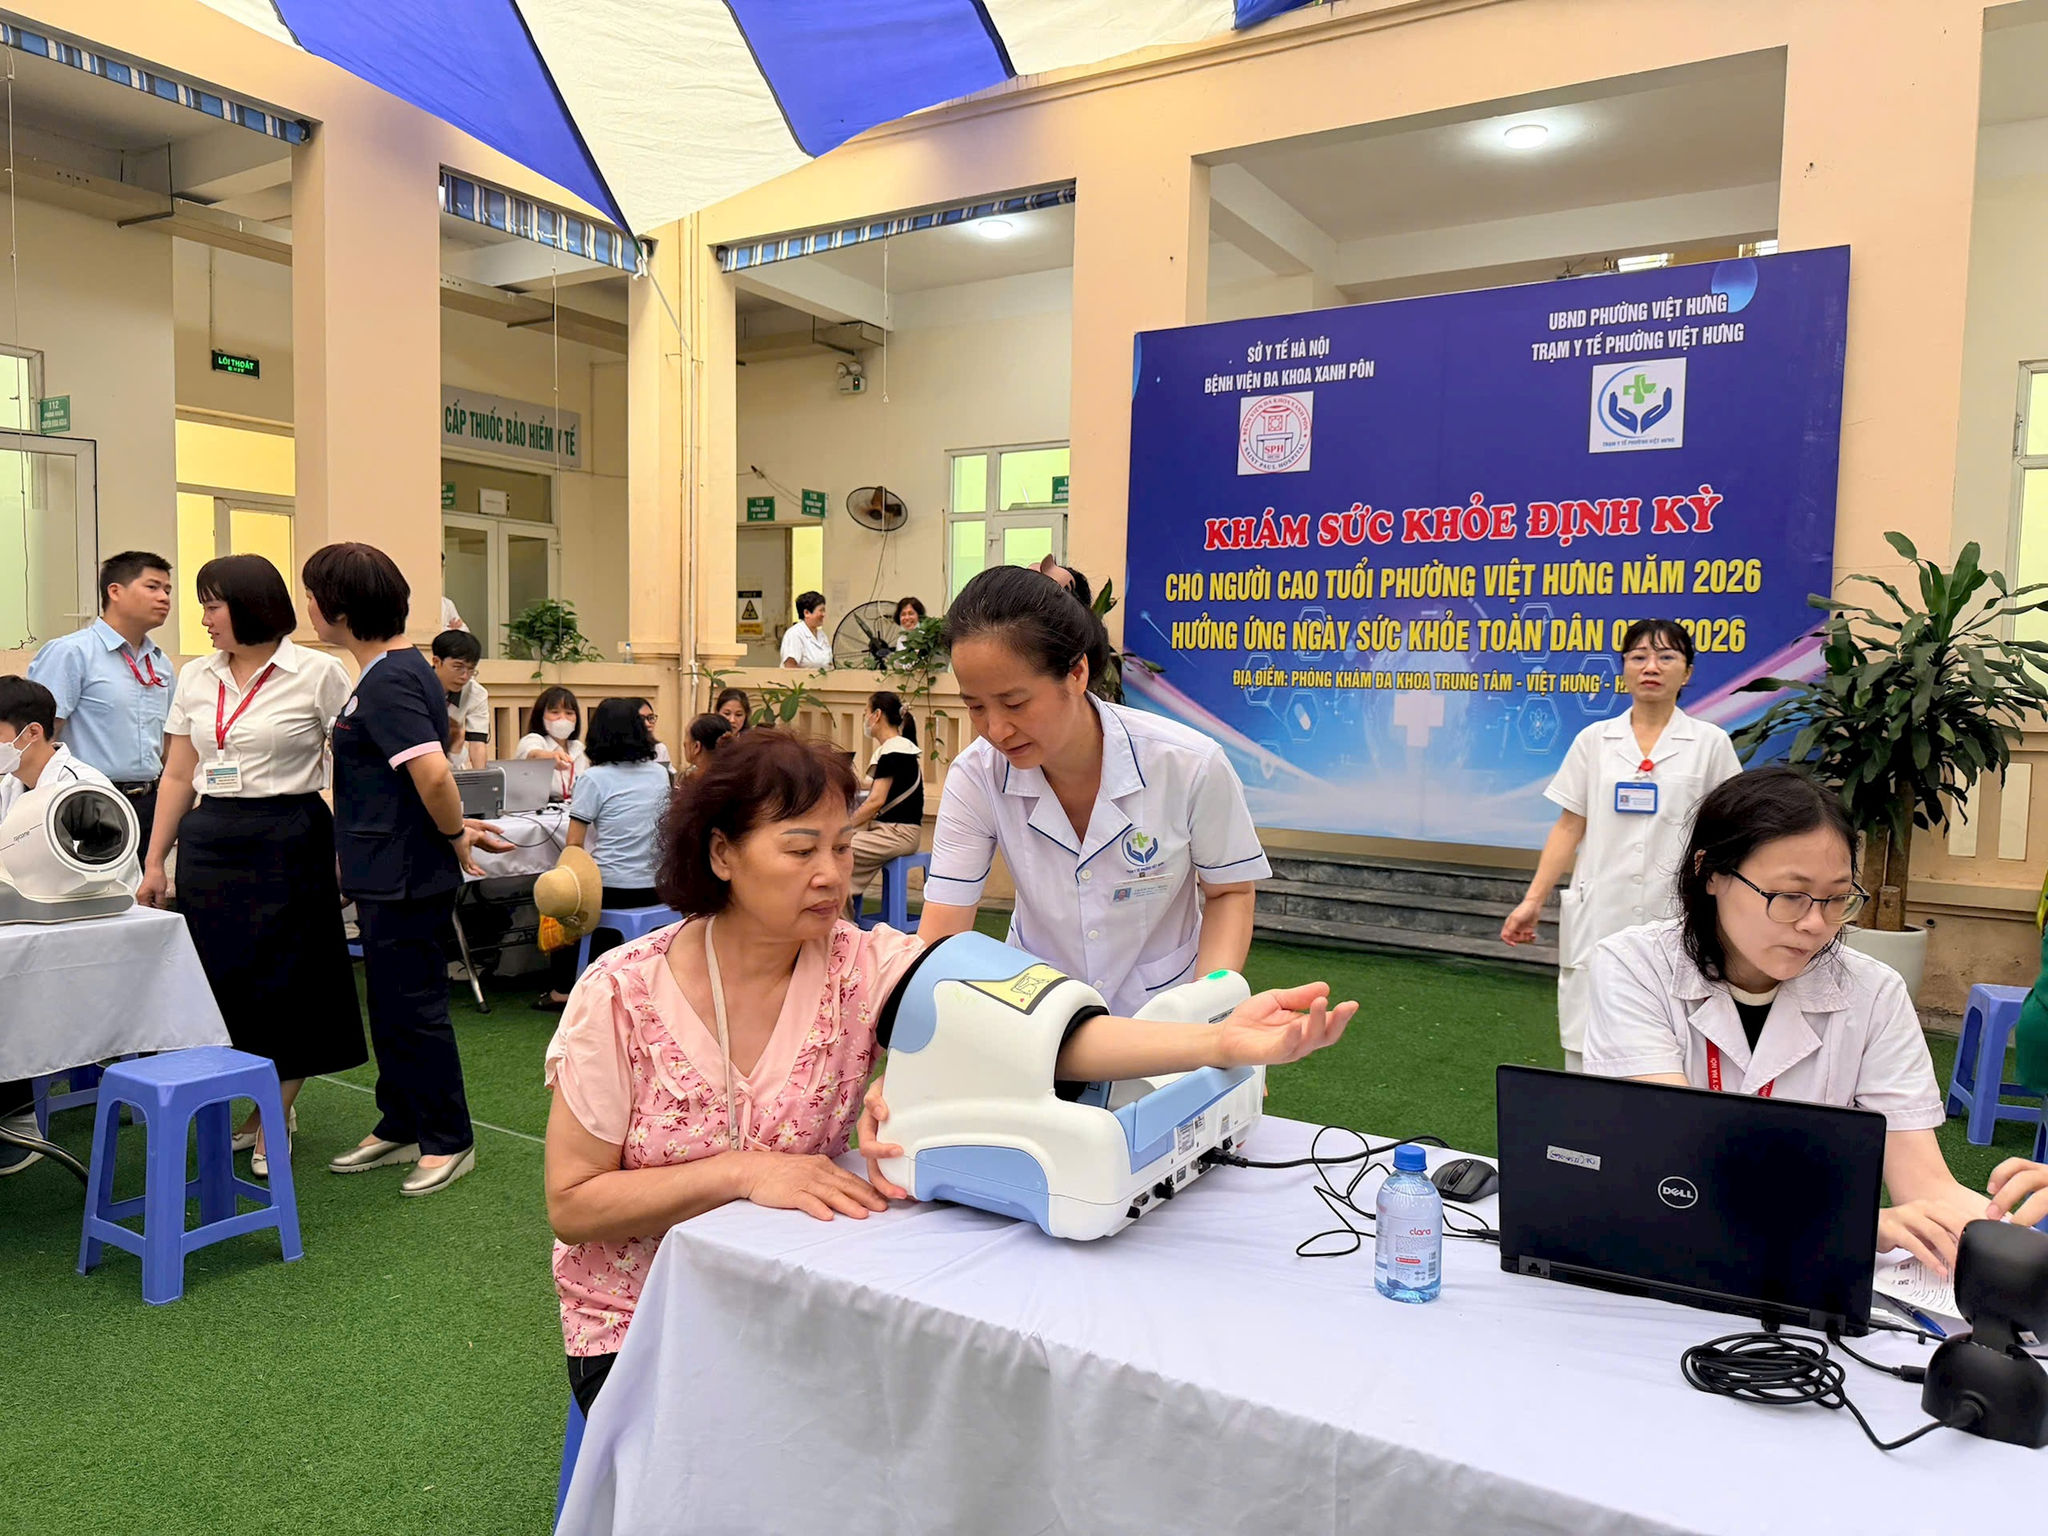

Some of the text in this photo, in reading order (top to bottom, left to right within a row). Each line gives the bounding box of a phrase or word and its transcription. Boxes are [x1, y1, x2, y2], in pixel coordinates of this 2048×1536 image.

[1549, 293, 1728, 330] UBND PHƯỜNG VIỆT HƯNG
[1247, 336, 1330, 363] SỞ Y TẾ HÀ NỘI
[1532, 323, 1745, 362] TRẠM Y TẾ PHƯỜNG VIỆT HƯNG
[1204, 358, 1375, 396] BỆNH VIỆN ĐA KHOA XANH PÔN
[445, 399, 467, 436] CẤP
[469, 406, 503, 442] THUỐC
[506, 410, 526, 447] BẢO
[529, 415, 554, 452] HIỂM
[564, 424, 576, 456] TẾ
[1264, 444, 1284, 453] SPH
[1204, 484, 1723, 550] KHÁM SỨC KHỎE ĐỊNH KỲ
[1165, 554, 1762, 603] CHO NGƯỜI CAO TUỔI PHƯỜNG VIỆT HƯNG NĂM 2026
[1171, 612, 1238, 650] HƯỞNG
[1243, 615, 1286, 650] ỨNG
[1292, 615, 1350, 651] NGÀY
[1356, 614, 1401, 651] SỨC
[1408, 610, 1470, 652] KHỎE
[1477, 613, 1543, 652] TOÀN
[1550, 612, 1605, 652] DÂN
[1233, 669, 1252, 689] ĐỊA
[1255, 664, 1288, 687] ĐIỂM:
[1291, 667, 1332, 688] PHÒNG
[1335, 667, 1372, 689] KHÁM
[1375, 672, 1393, 689] ĐA
[1396, 672, 1431, 689] KHOA
[1435, 672, 1479, 690] TRUNG
[1482, 670, 1513, 691] TÂM
[1526, 673, 1556, 696] VIỆT
[1560, 673, 1601, 693] HƯNG
[1662, 1185, 1694, 1199] DELL
